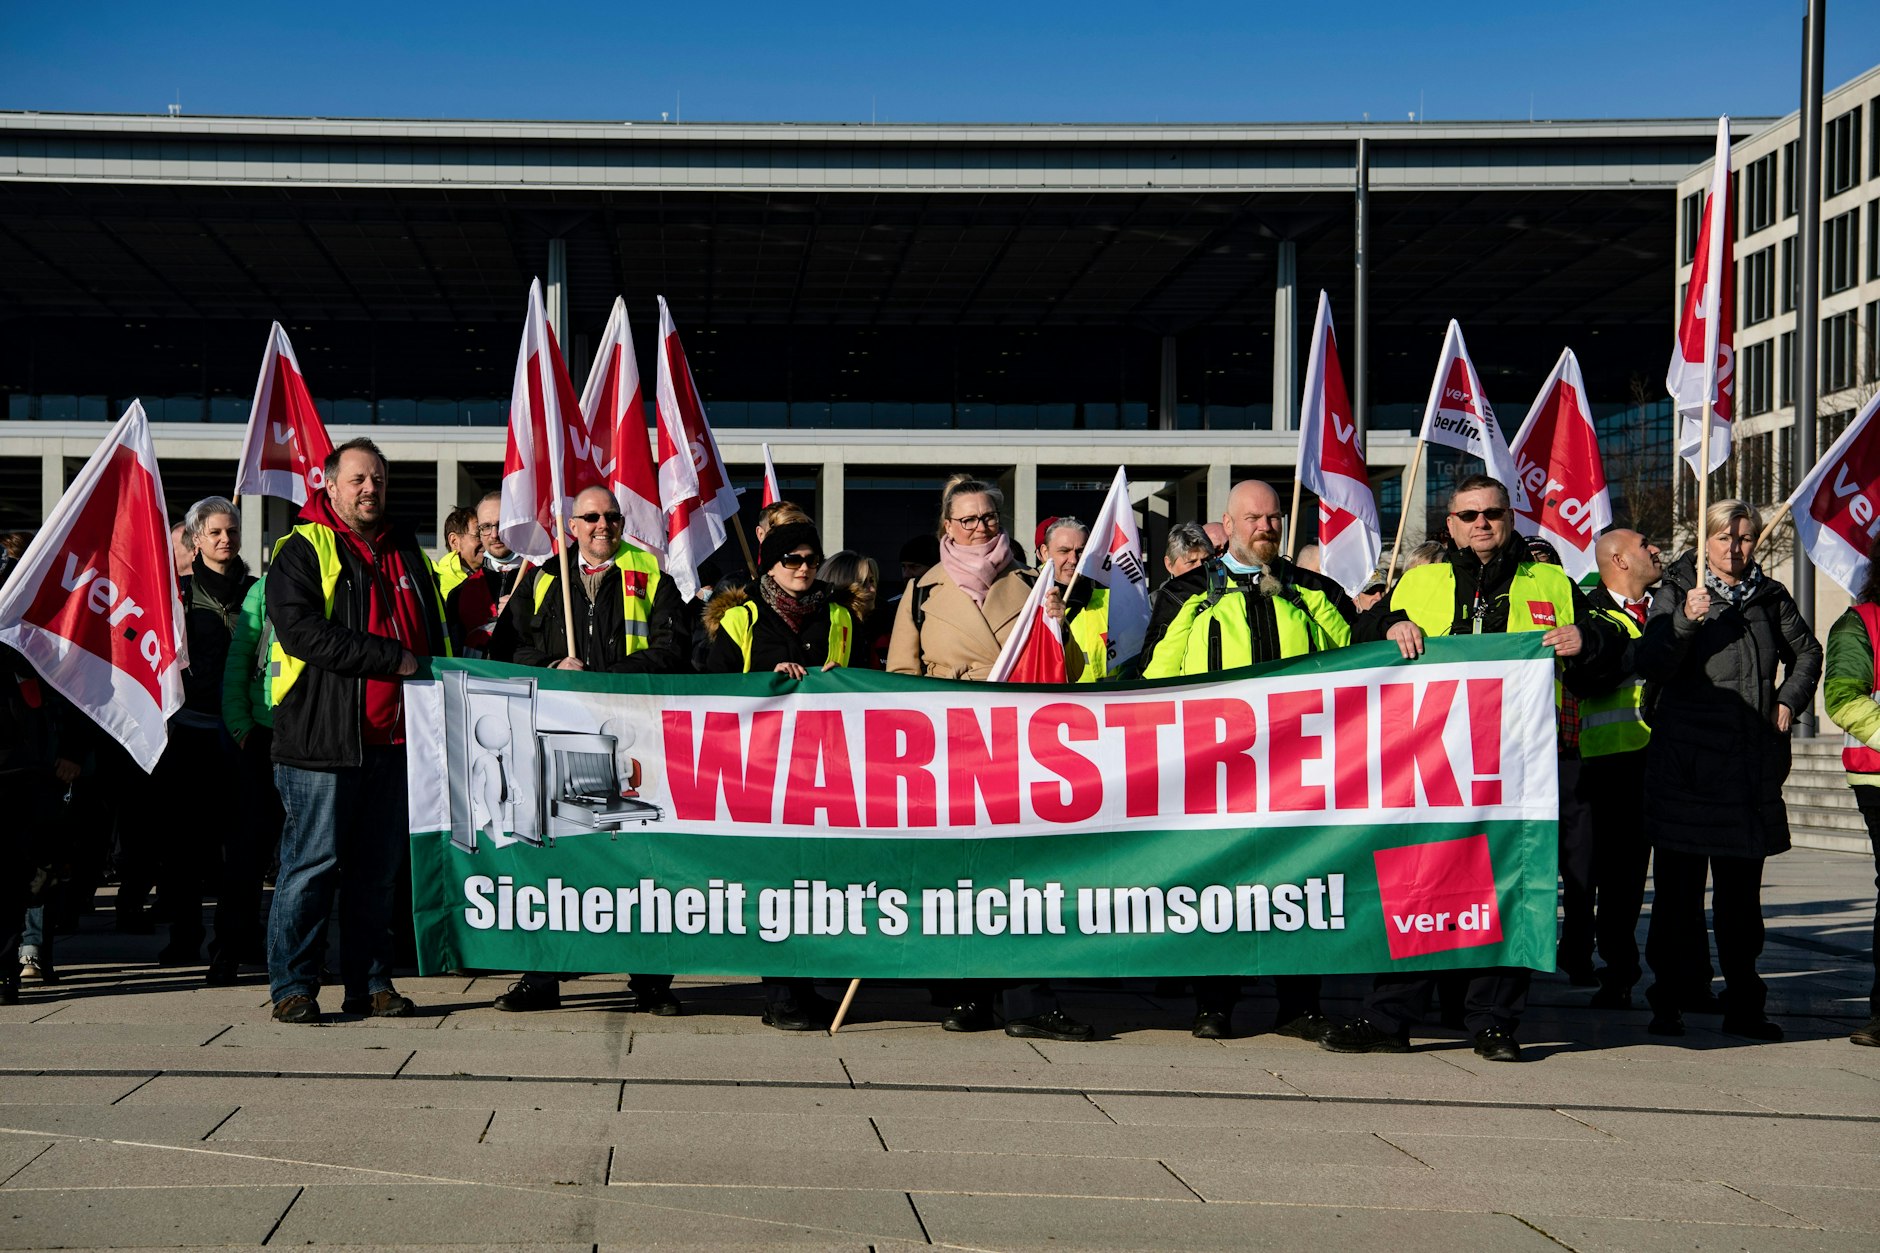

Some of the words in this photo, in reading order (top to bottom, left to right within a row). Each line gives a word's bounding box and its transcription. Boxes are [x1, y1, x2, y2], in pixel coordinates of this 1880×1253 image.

[661, 678, 1504, 827] WARNSTREIK!
[464, 875, 747, 935] Sicherheit
[922, 878, 1067, 936] nicht
[1077, 873, 1346, 936] umsonst!
[1392, 904, 1492, 934] ver.di
